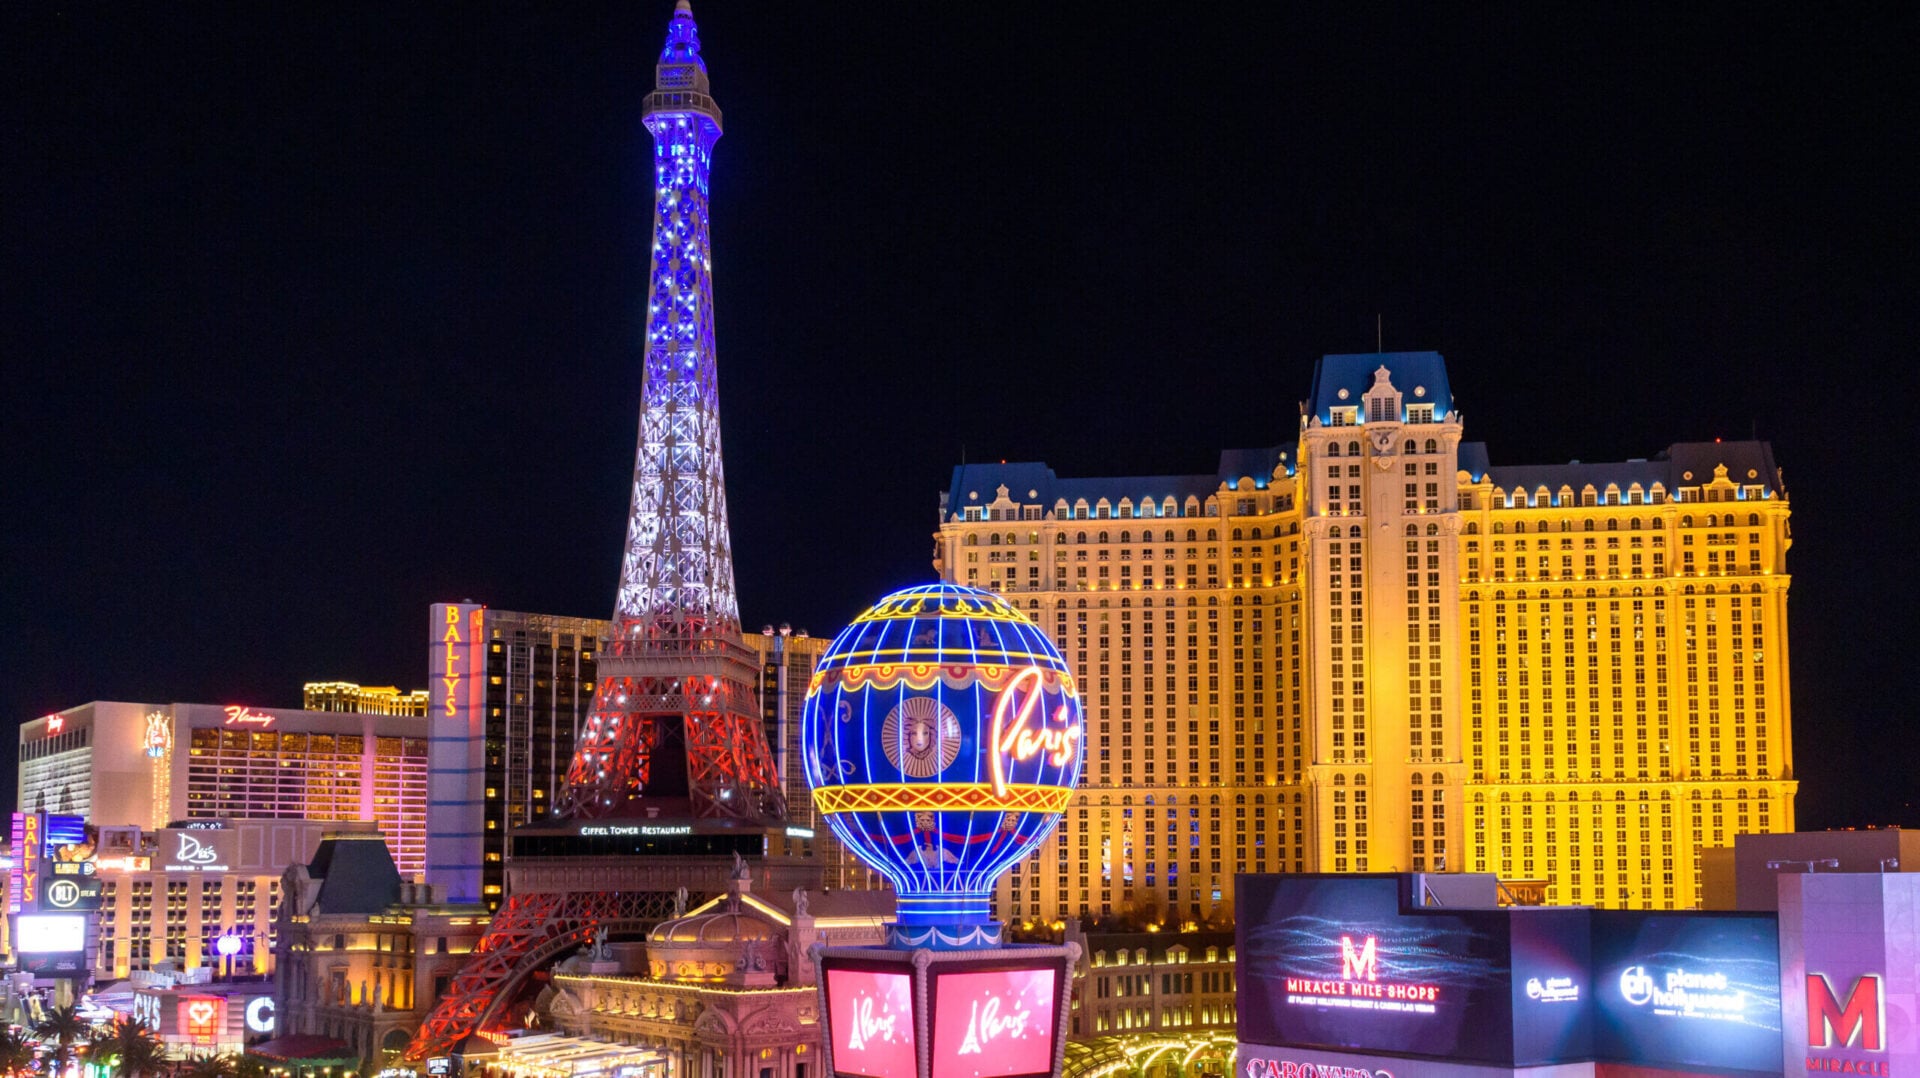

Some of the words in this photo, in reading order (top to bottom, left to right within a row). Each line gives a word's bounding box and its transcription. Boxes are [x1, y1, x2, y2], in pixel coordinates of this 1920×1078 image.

[987, 665, 1081, 798] Paris
[581, 826, 608, 835] EIFFEL
[610, 826, 638, 835] TOWER
[642, 826, 691, 835] RESTAURANT
[55, 885, 74, 901] BLT
[1341, 935, 1377, 982] M
[1287, 978, 1346, 996] MIRACLE
[1351, 983, 1382, 997] MILE
[1666, 968, 1728, 992] planet
[134, 993, 161, 1031] CVS
[860, 997, 896, 1041] Paris
[980, 997, 1030, 1043] Paris
[1806, 973, 1885, 1051] M
[1806, 1057, 1889, 1078] MIRACLE
